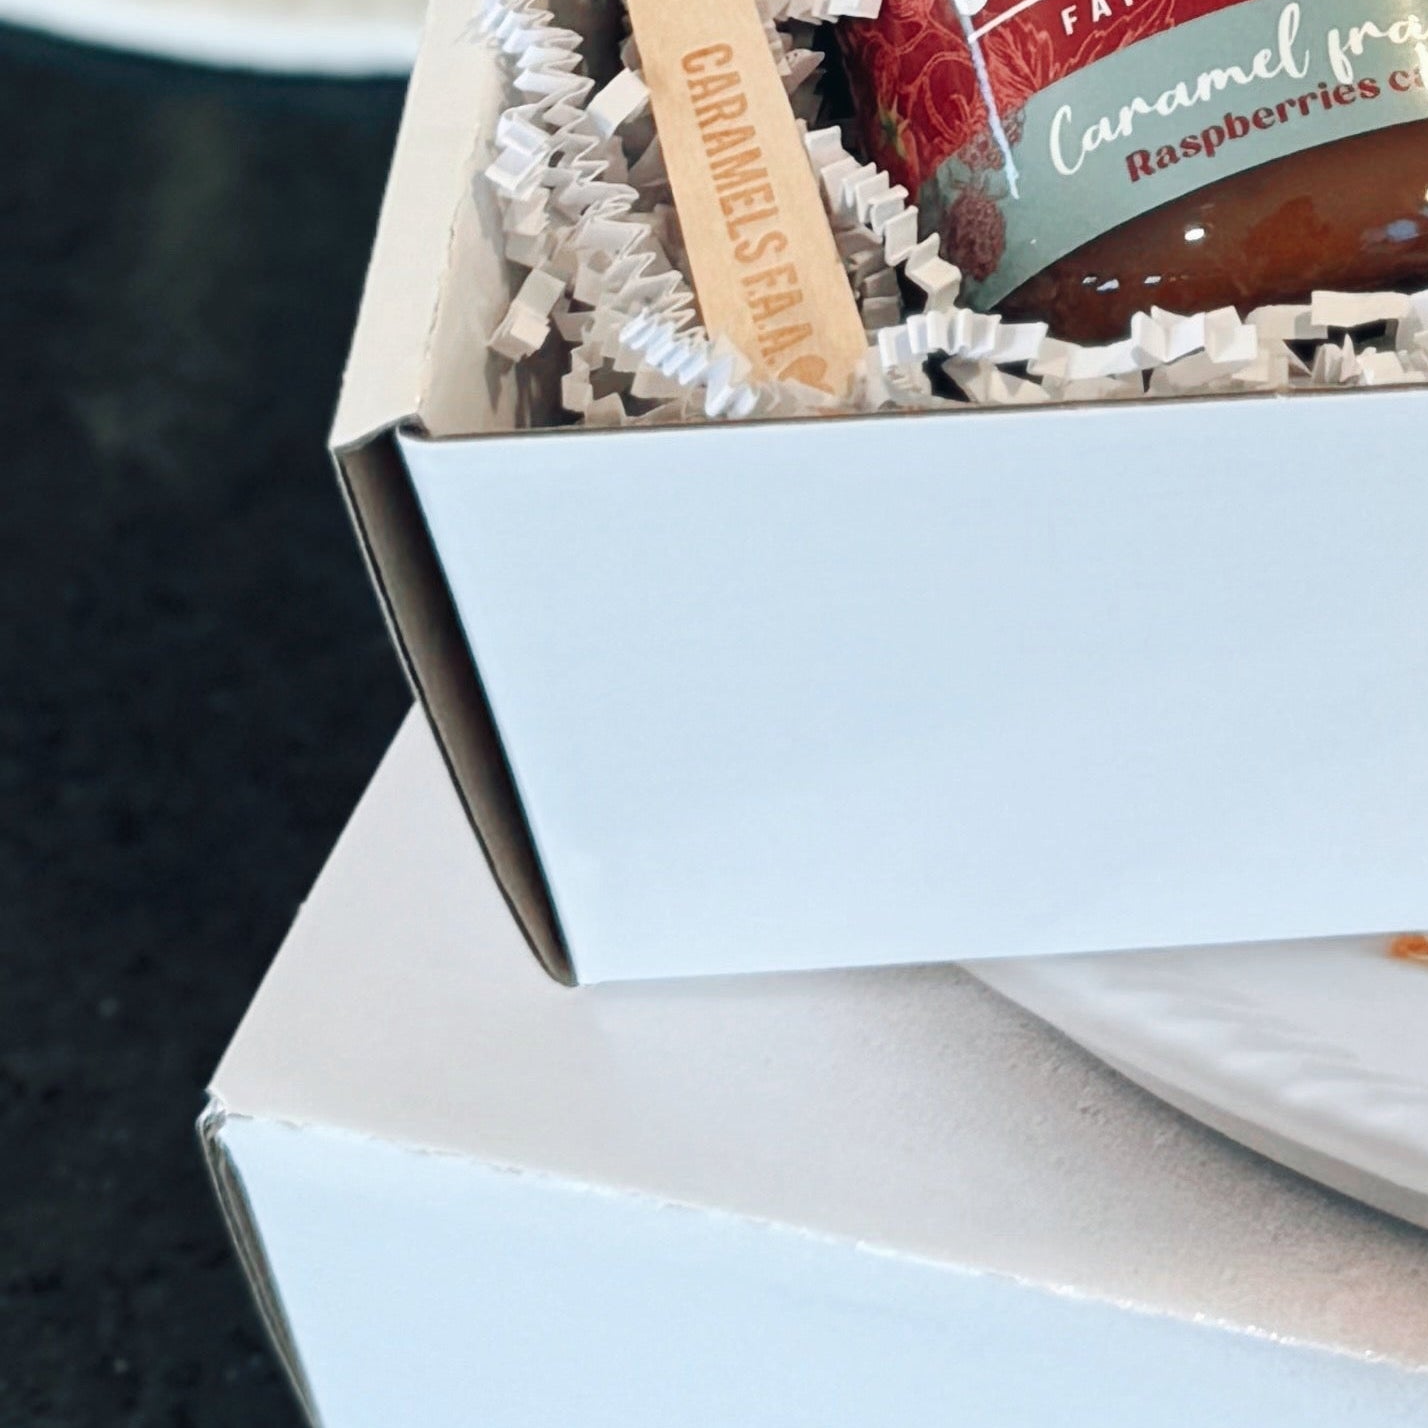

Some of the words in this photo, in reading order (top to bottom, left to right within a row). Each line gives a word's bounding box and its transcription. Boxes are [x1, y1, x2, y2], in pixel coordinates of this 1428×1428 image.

[682, 43, 790, 265] CARAMELS
[1049, 2, 1311, 176] Caramel
[1125, 74, 1381, 184] Raspberries
